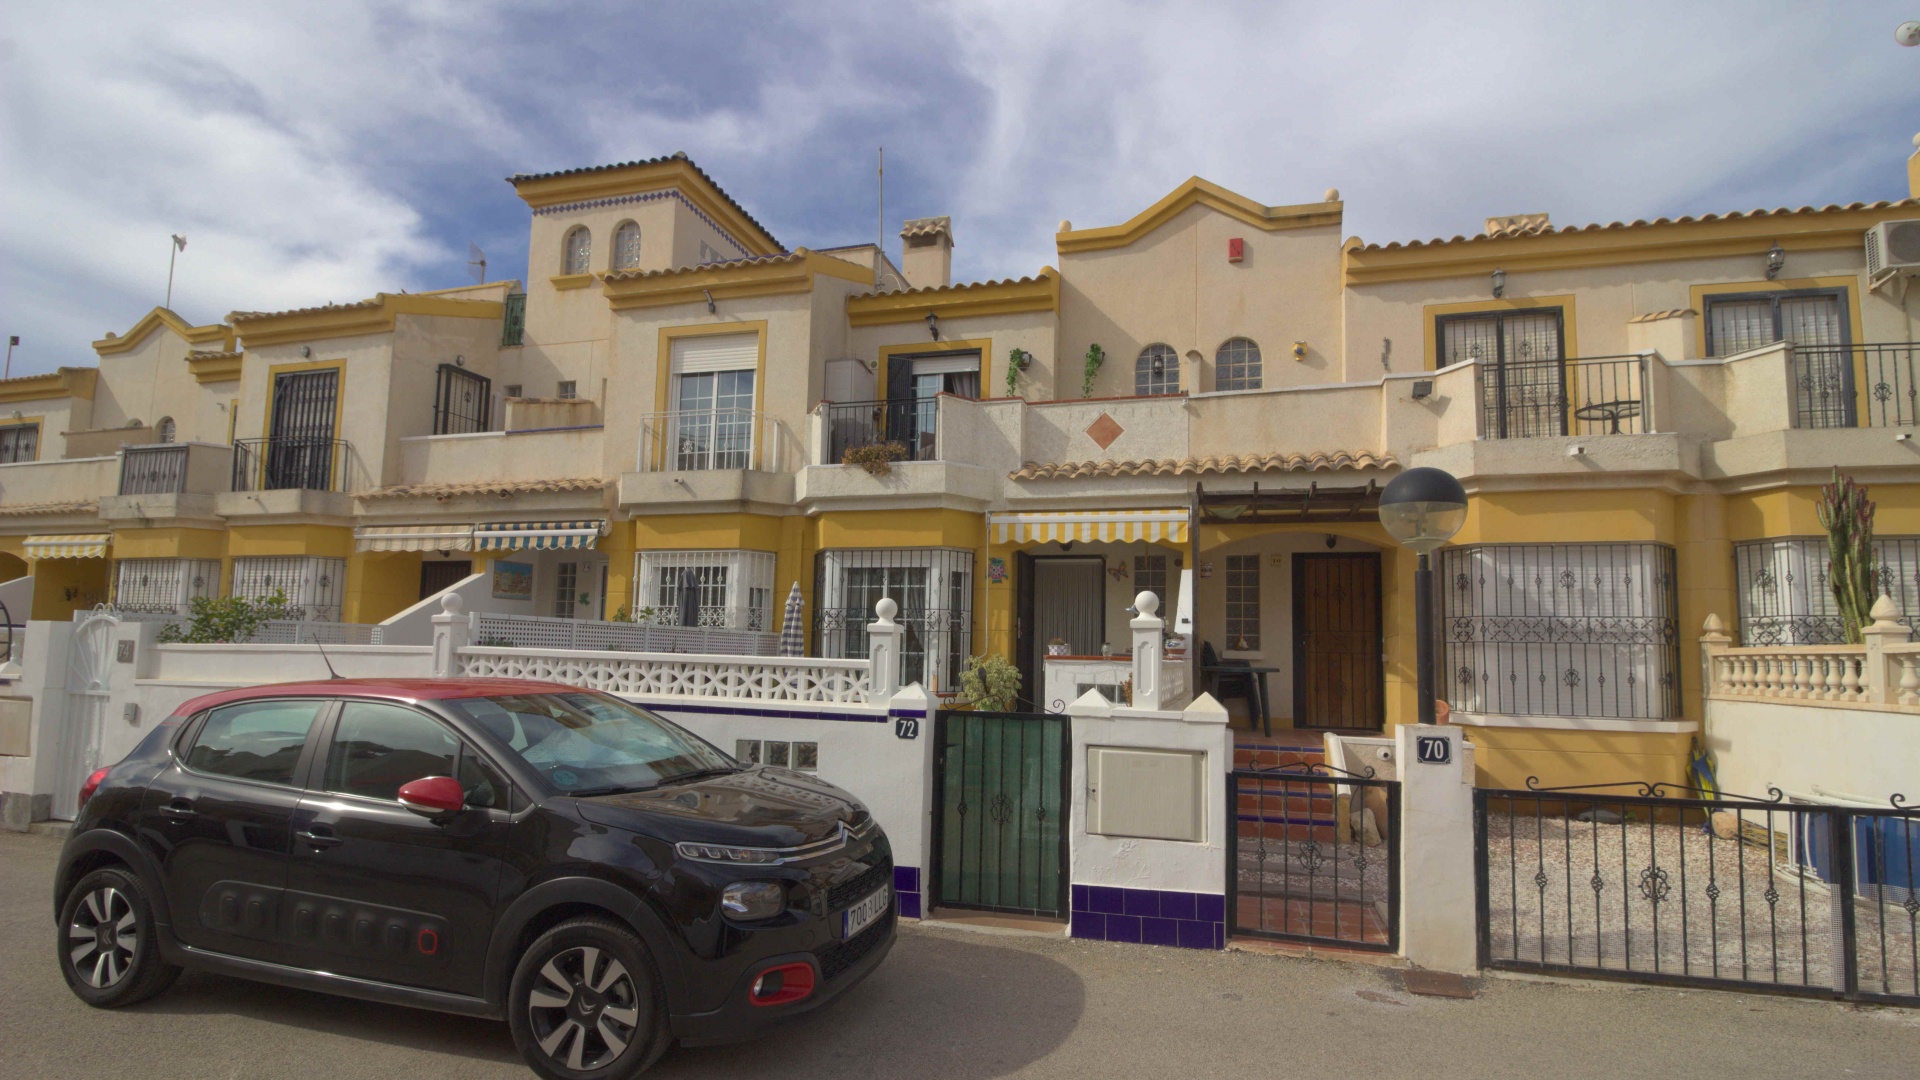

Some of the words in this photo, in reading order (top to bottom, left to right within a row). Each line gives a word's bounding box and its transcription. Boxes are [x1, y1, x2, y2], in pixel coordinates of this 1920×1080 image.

[119, 643, 130, 658] 74
[899, 720, 915, 737] 72
[1424, 740, 1444, 759] 70
[874, 888, 888, 914] LLG
